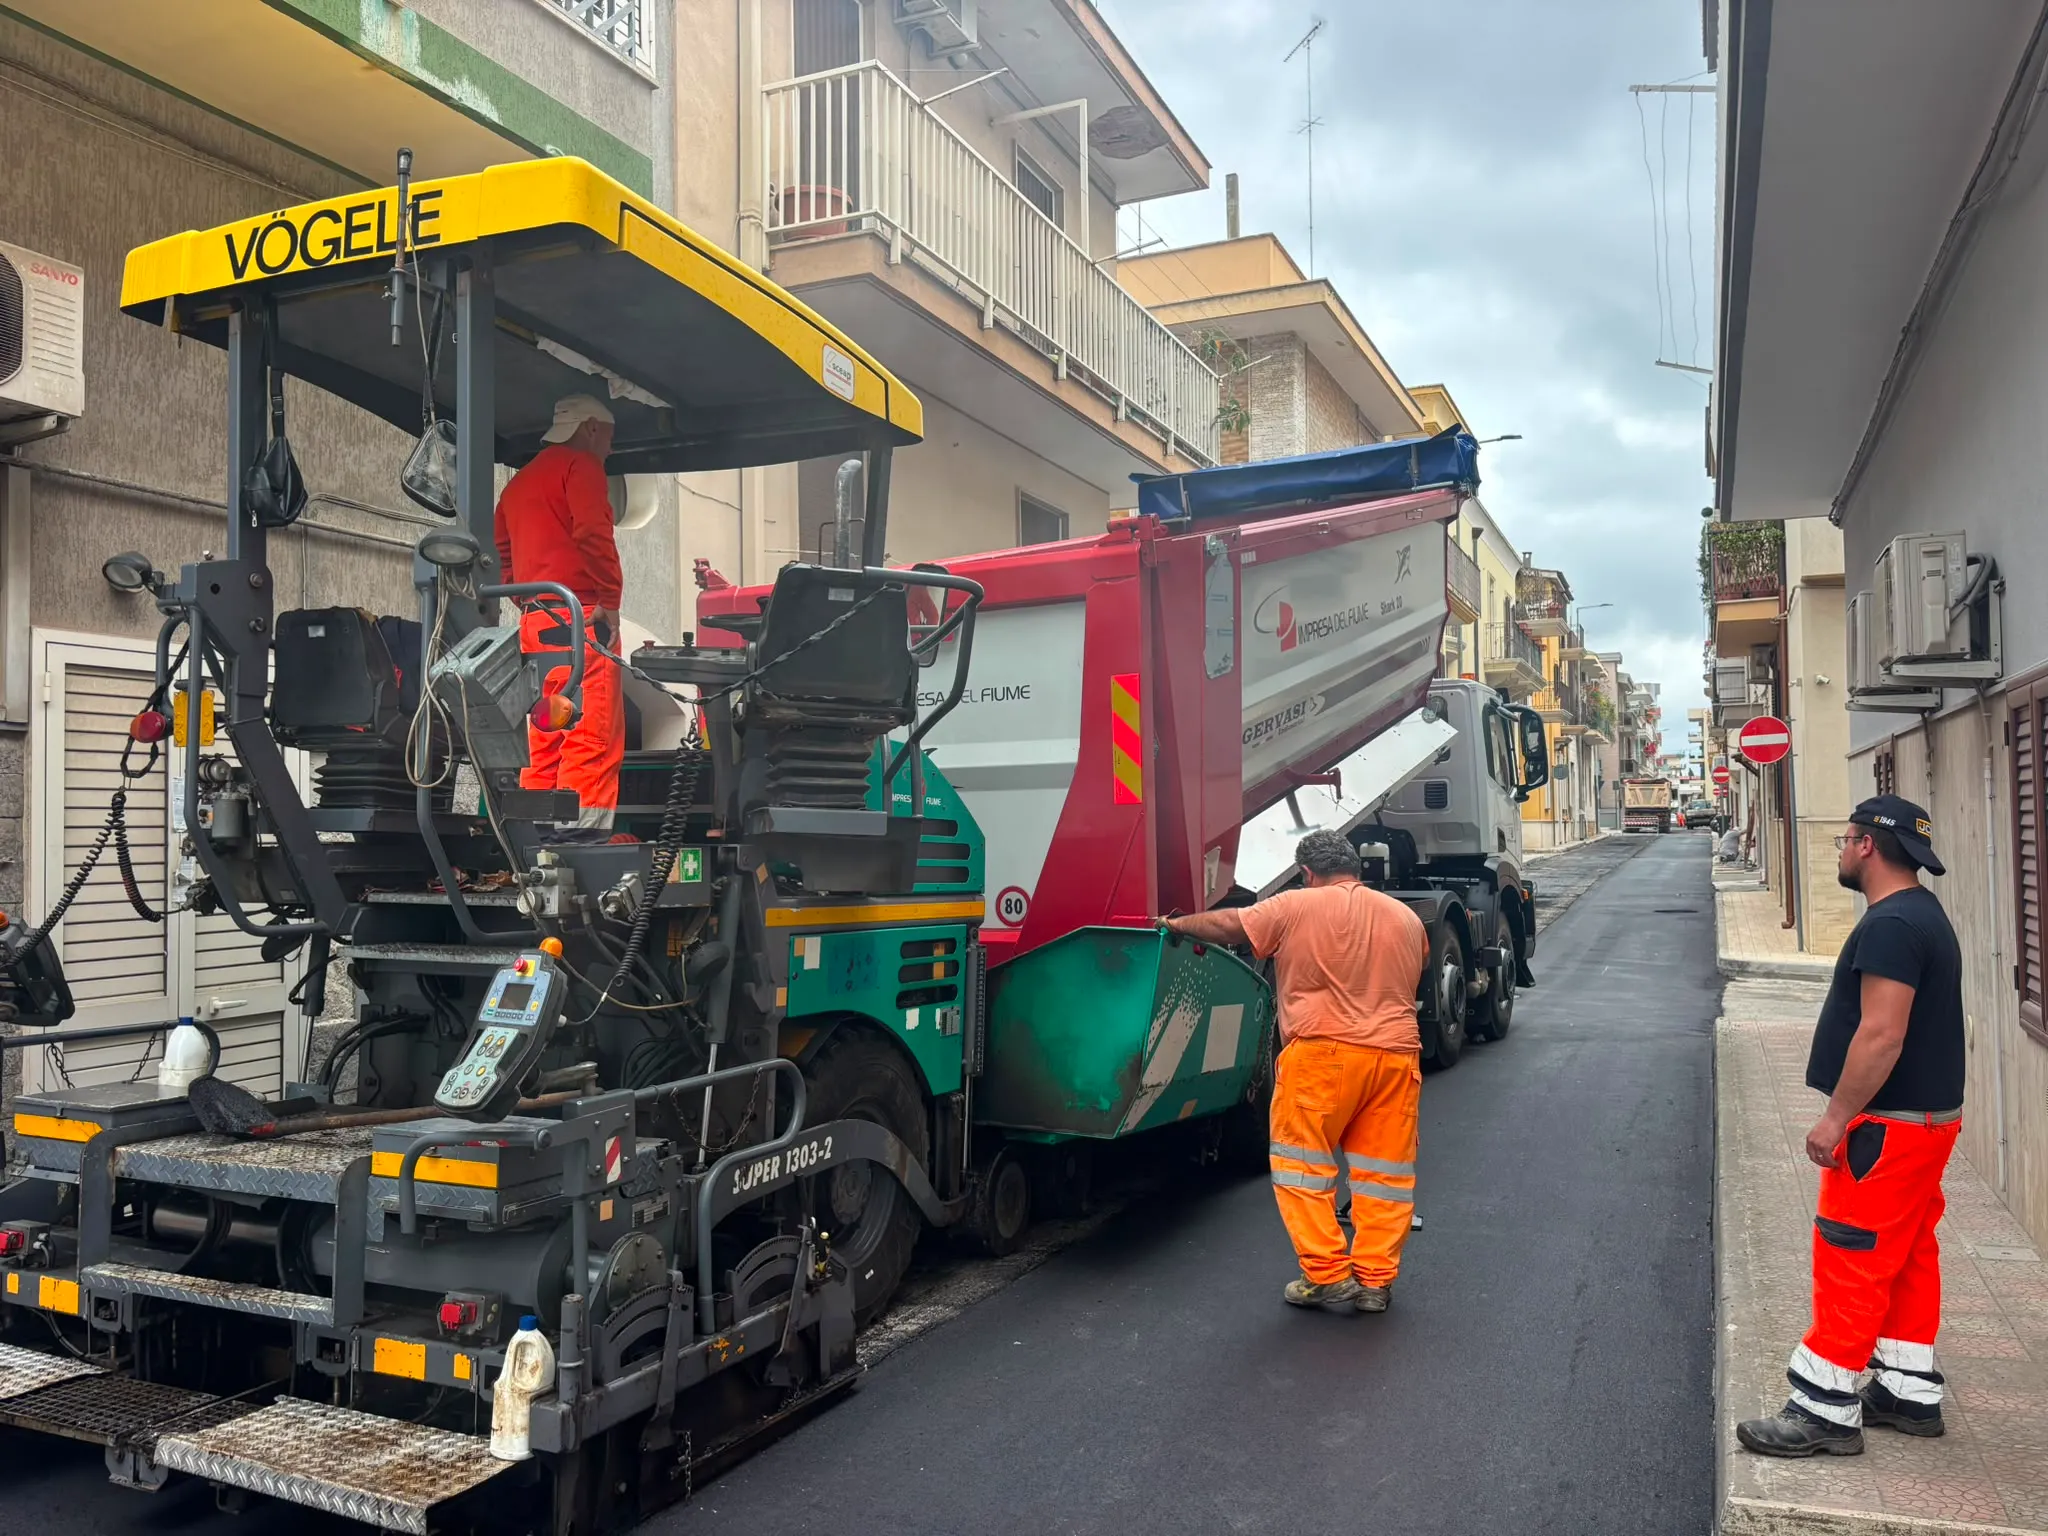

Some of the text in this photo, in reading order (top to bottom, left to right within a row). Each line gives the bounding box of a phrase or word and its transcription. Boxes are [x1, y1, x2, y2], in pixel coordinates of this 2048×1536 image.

[225, 189, 443, 280] VÖGELE
[30, 262, 79, 286] SANYO
[1298, 602, 1369, 645] IMPRESA DEL FIUME
[960, 689, 979, 703] EL
[981, 685, 1031, 703] FIUME
[1242, 701, 1307, 744] GERVASI
[1880, 816, 1896, 826] 1945
[1919, 822, 1932, 832] JC
[1005, 898, 1023, 915] 80
[732, 1136, 833, 1195] SUPER 1303-2
